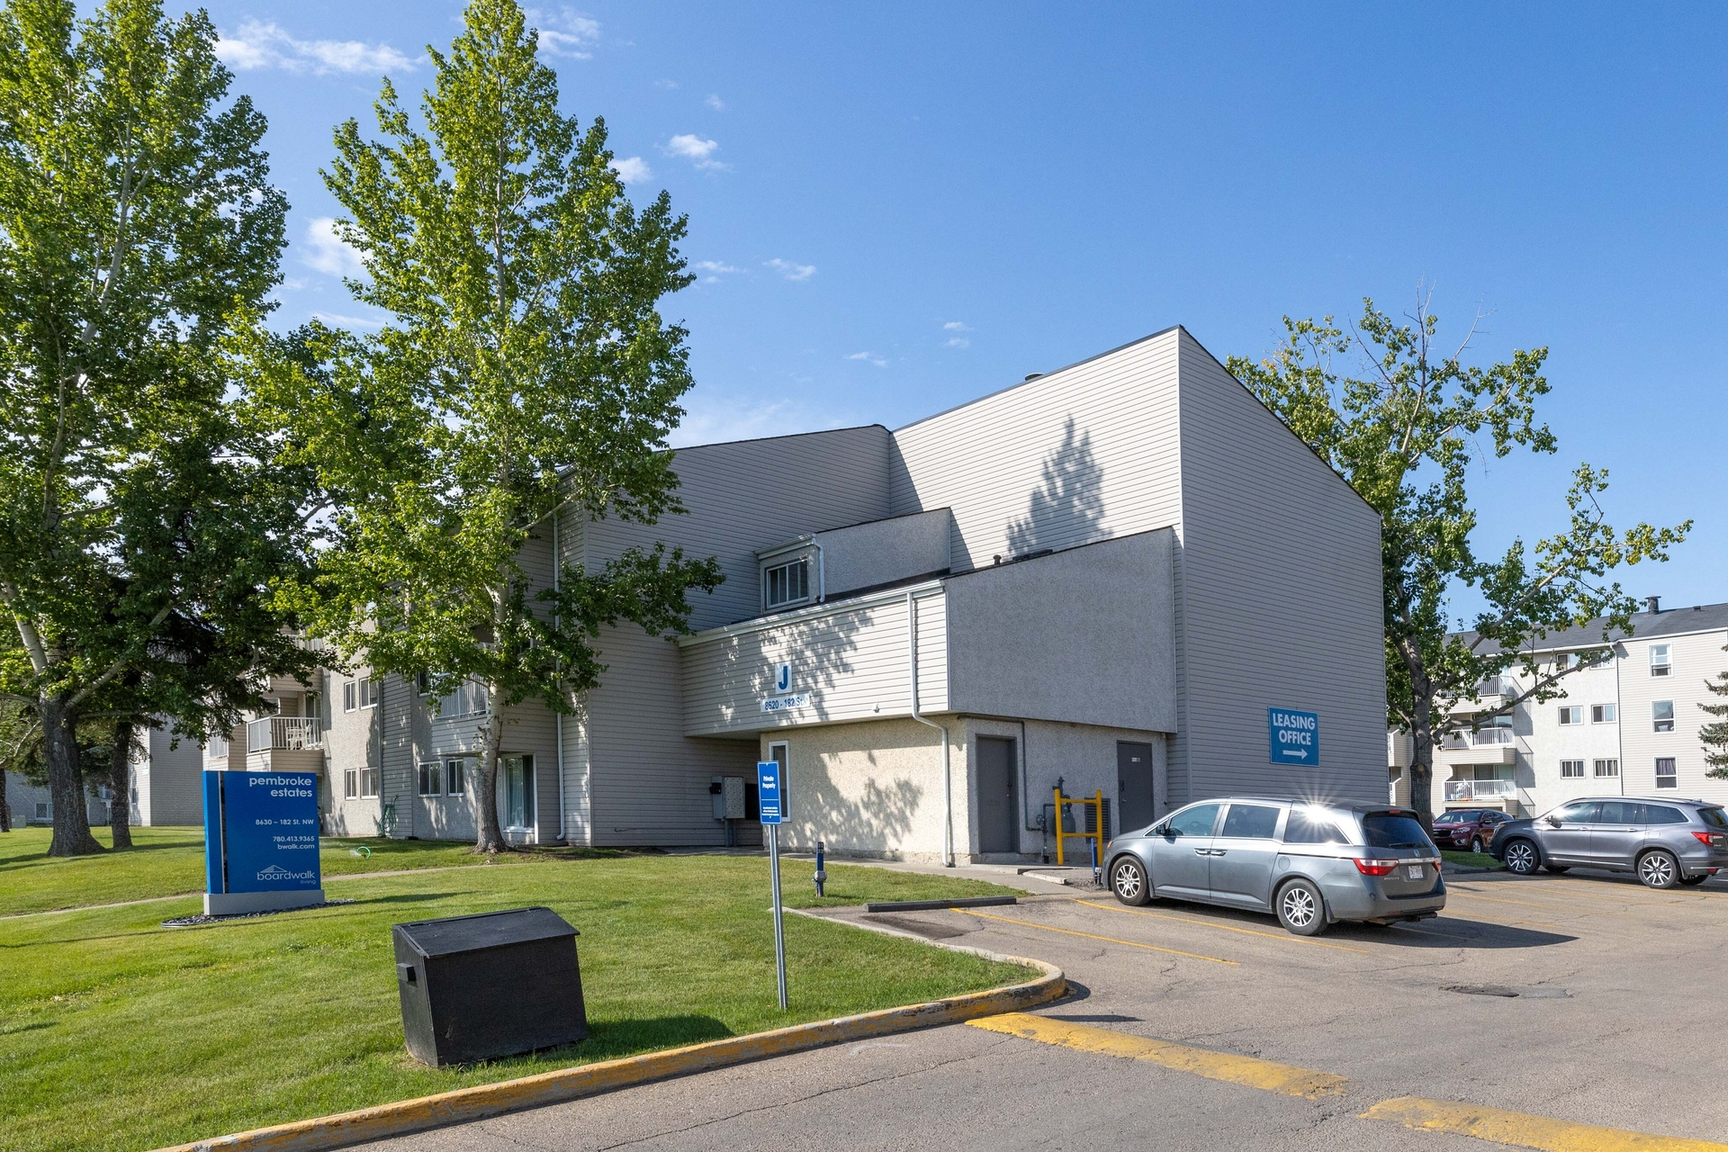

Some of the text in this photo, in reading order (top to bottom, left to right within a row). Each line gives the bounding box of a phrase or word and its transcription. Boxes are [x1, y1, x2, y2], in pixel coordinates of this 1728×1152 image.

[778, 665, 788, 690] J
[1272, 713, 1316, 730] LEASING
[1278, 730, 1312, 745] OFFICE
[249, 776, 312, 787] pembroke
[270, 787, 313, 797] estates
[256, 871, 316, 880] boardwalk
